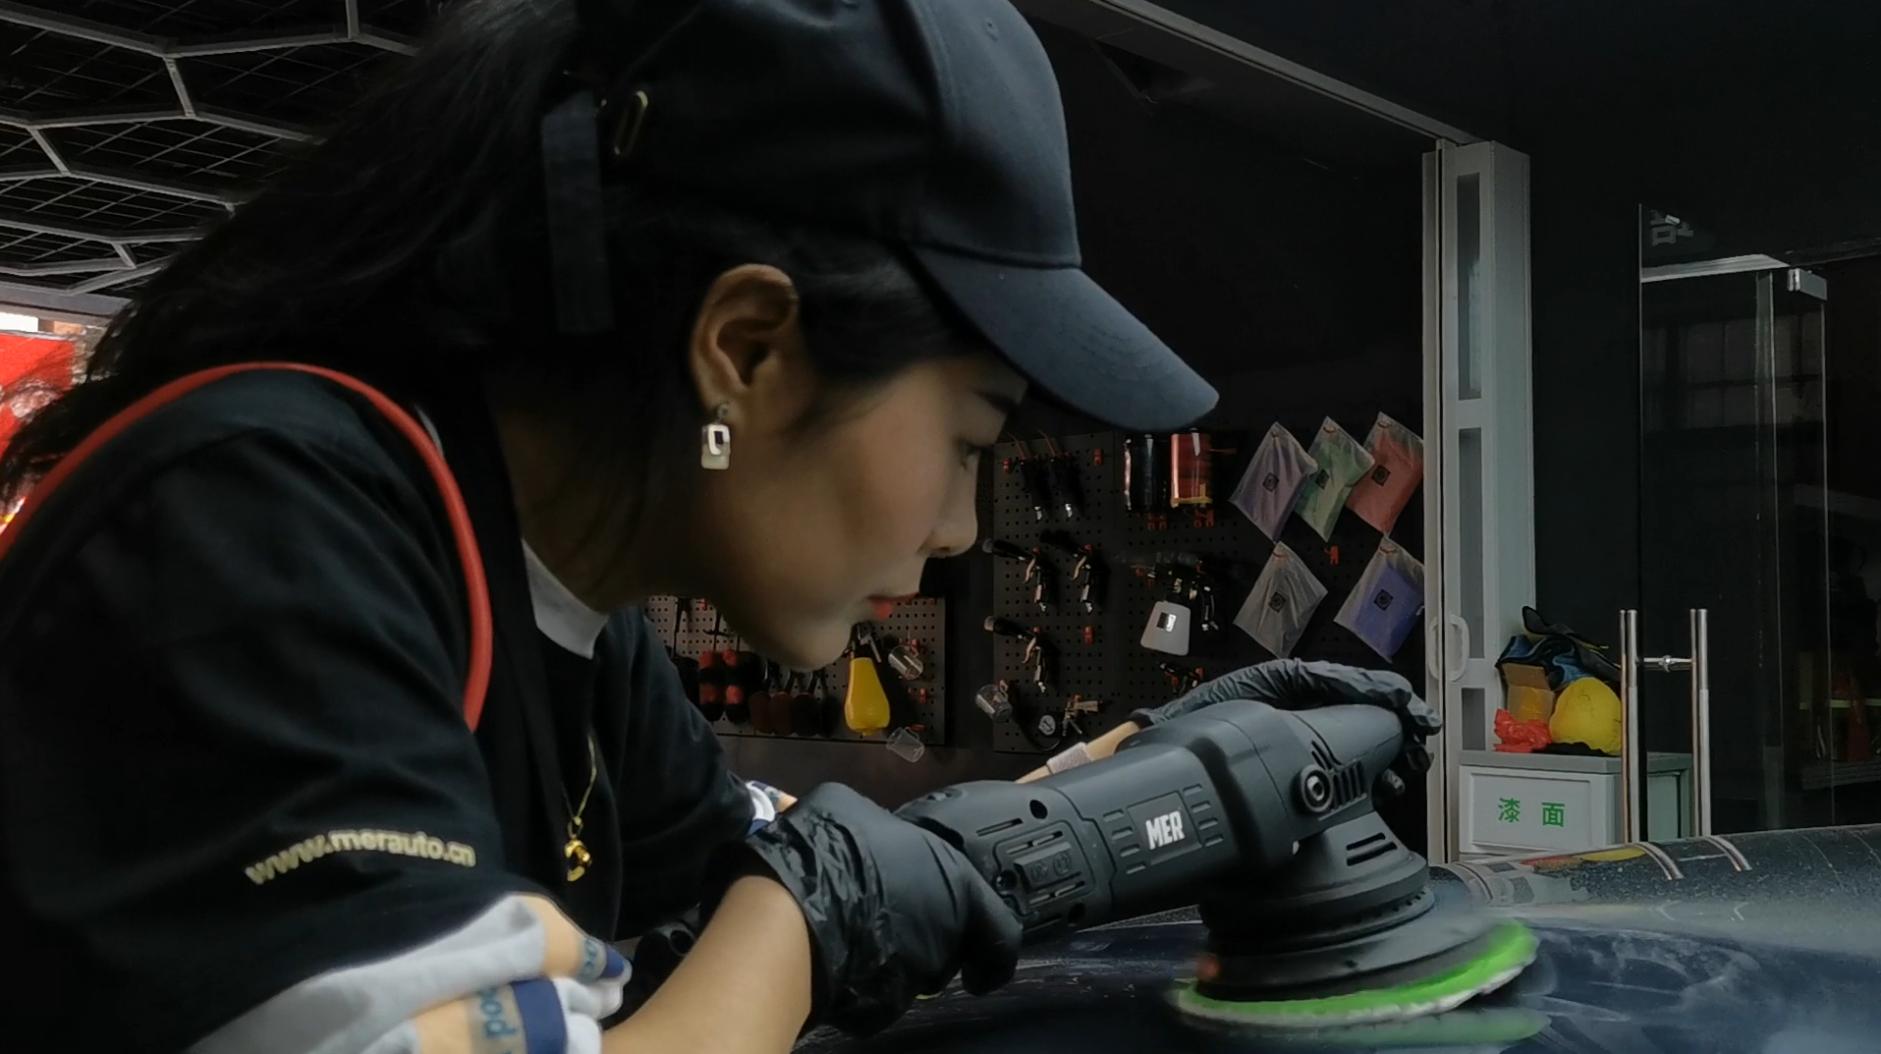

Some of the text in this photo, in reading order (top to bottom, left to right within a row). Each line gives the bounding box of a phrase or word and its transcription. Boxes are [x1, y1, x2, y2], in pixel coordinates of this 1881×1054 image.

[1145, 811, 1185, 850] MER
[1498, 797, 1565, 828] 漆面
[244, 829, 477, 884] www.merauto.cn
